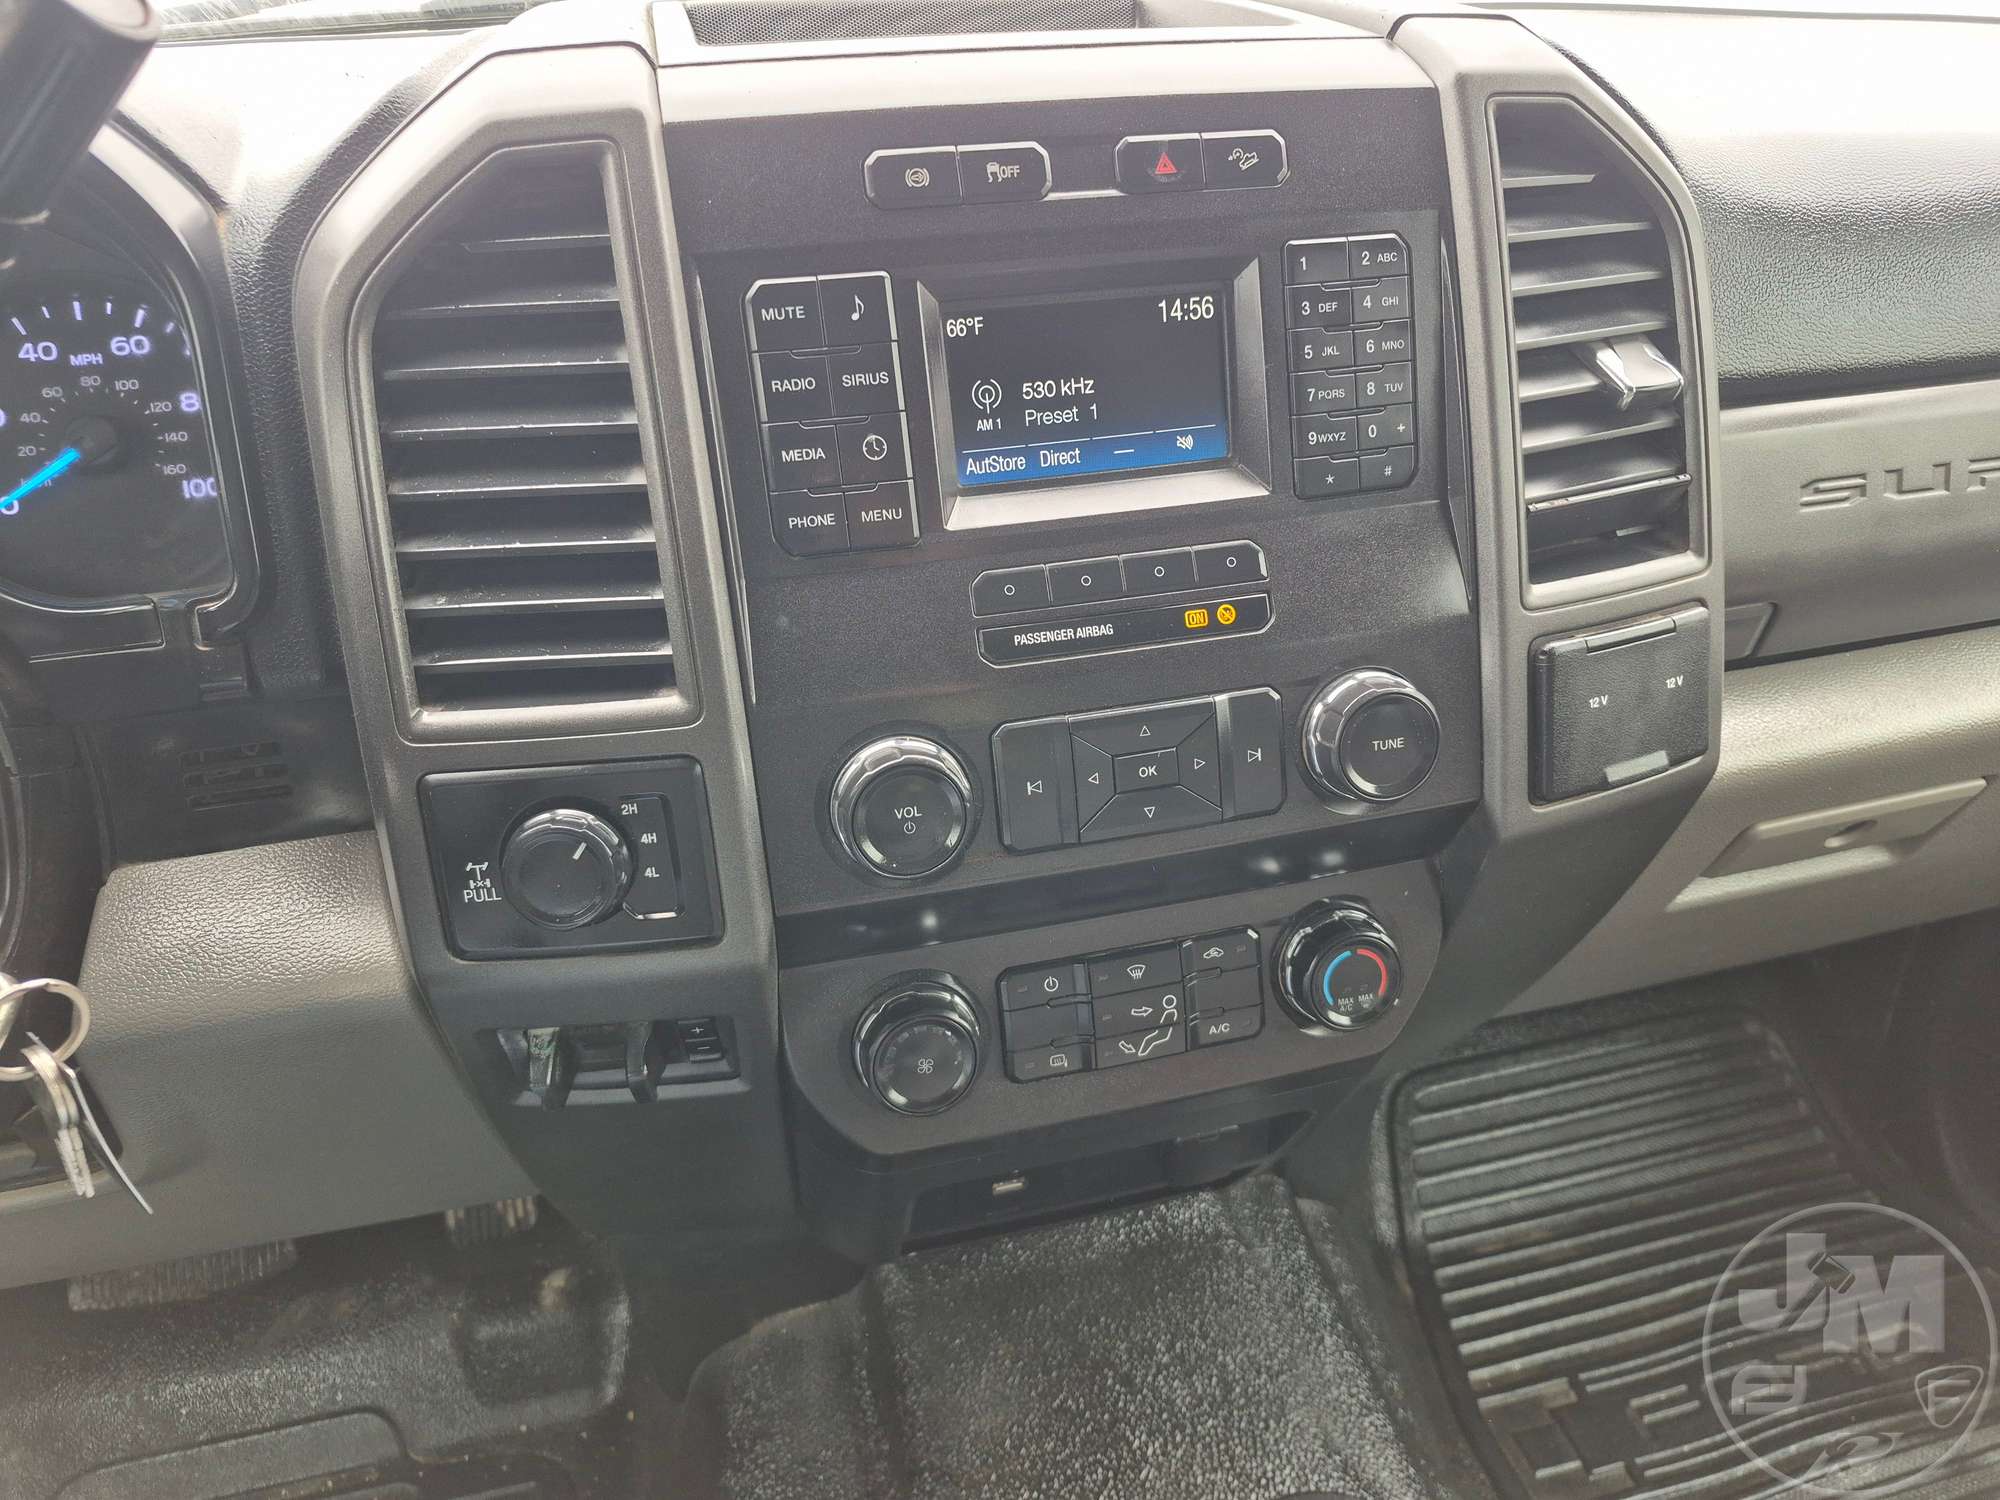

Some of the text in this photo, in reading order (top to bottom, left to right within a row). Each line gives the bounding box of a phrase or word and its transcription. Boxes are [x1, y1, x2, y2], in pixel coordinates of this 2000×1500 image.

[1000, 165, 1020, 178] OFF
[1299, 256, 1307, 271] 1
[1361, 251, 1398, 266] 2 ABC
[1158, 295, 1215, 323] 14:56
[1301, 301, 1338, 315] 3 DEF
[1363, 295, 1399, 309] 4 GHI
[761, 305, 806, 321] MUTE
[946, 316, 984, 338] 66°F
[18, 341, 59, 362] 40
[109, 335, 151, 356] 60
[1304, 345, 1340, 359] 5 JKL
[1366, 339, 1405, 353] 6 MNO
[69, 353, 104, 367] MPH
[80, 375, 101, 387] 80
[114, 379, 140, 391] 100
[771, 377, 816, 393] RADIO
[842, 371, 889, 388] SIRIUS
[41, 386, 64, 399] 60
[1022, 376, 1095, 400] 530 kHz
[1307, 388, 1345, 402] 7 PQRS
[1367, 381, 1404, 396] 8 TUV
[150, 401, 173, 414] 120
[179, 391, 202, 413] 8
[20, 412, 42, 424] 40
[1025, 402, 1098, 427] Preset 1
[976, 418, 994, 432] AM
[1368, 424, 1377, 438] 0
[164, 431, 189, 443] 140
[1308, 431, 1346, 445] 9 WXYZ
[17, 446, 37, 457] 20
[781, 448, 826, 463] MEDIA
[1040, 448, 1081, 468] Direct
[163, 463, 187, 475] 160
[966, 454, 1027, 476] AutStore
[788, 513, 836, 529] PHONE
[861, 508, 903, 523] MENU
[1189, 612, 1204, 626] ON
[1014, 624, 1114, 647] PASSENGER AIRBAG
[1371, 737, 1405, 752] TUNE
[1138, 765, 1158, 778] OK
[621, 804, 638, 815] 2H
[894, 807, 922, 820] VOL
[640, 833, 657, 844] 4H
[644, 867, 660, 878] 4L
[463, 889, 502, 903] PULL
[1338, 997, 1354, 1006] MAX
[1358, 993, 1373, 1002] MAX
[1208, 1022, 1231, 1036] A/C
